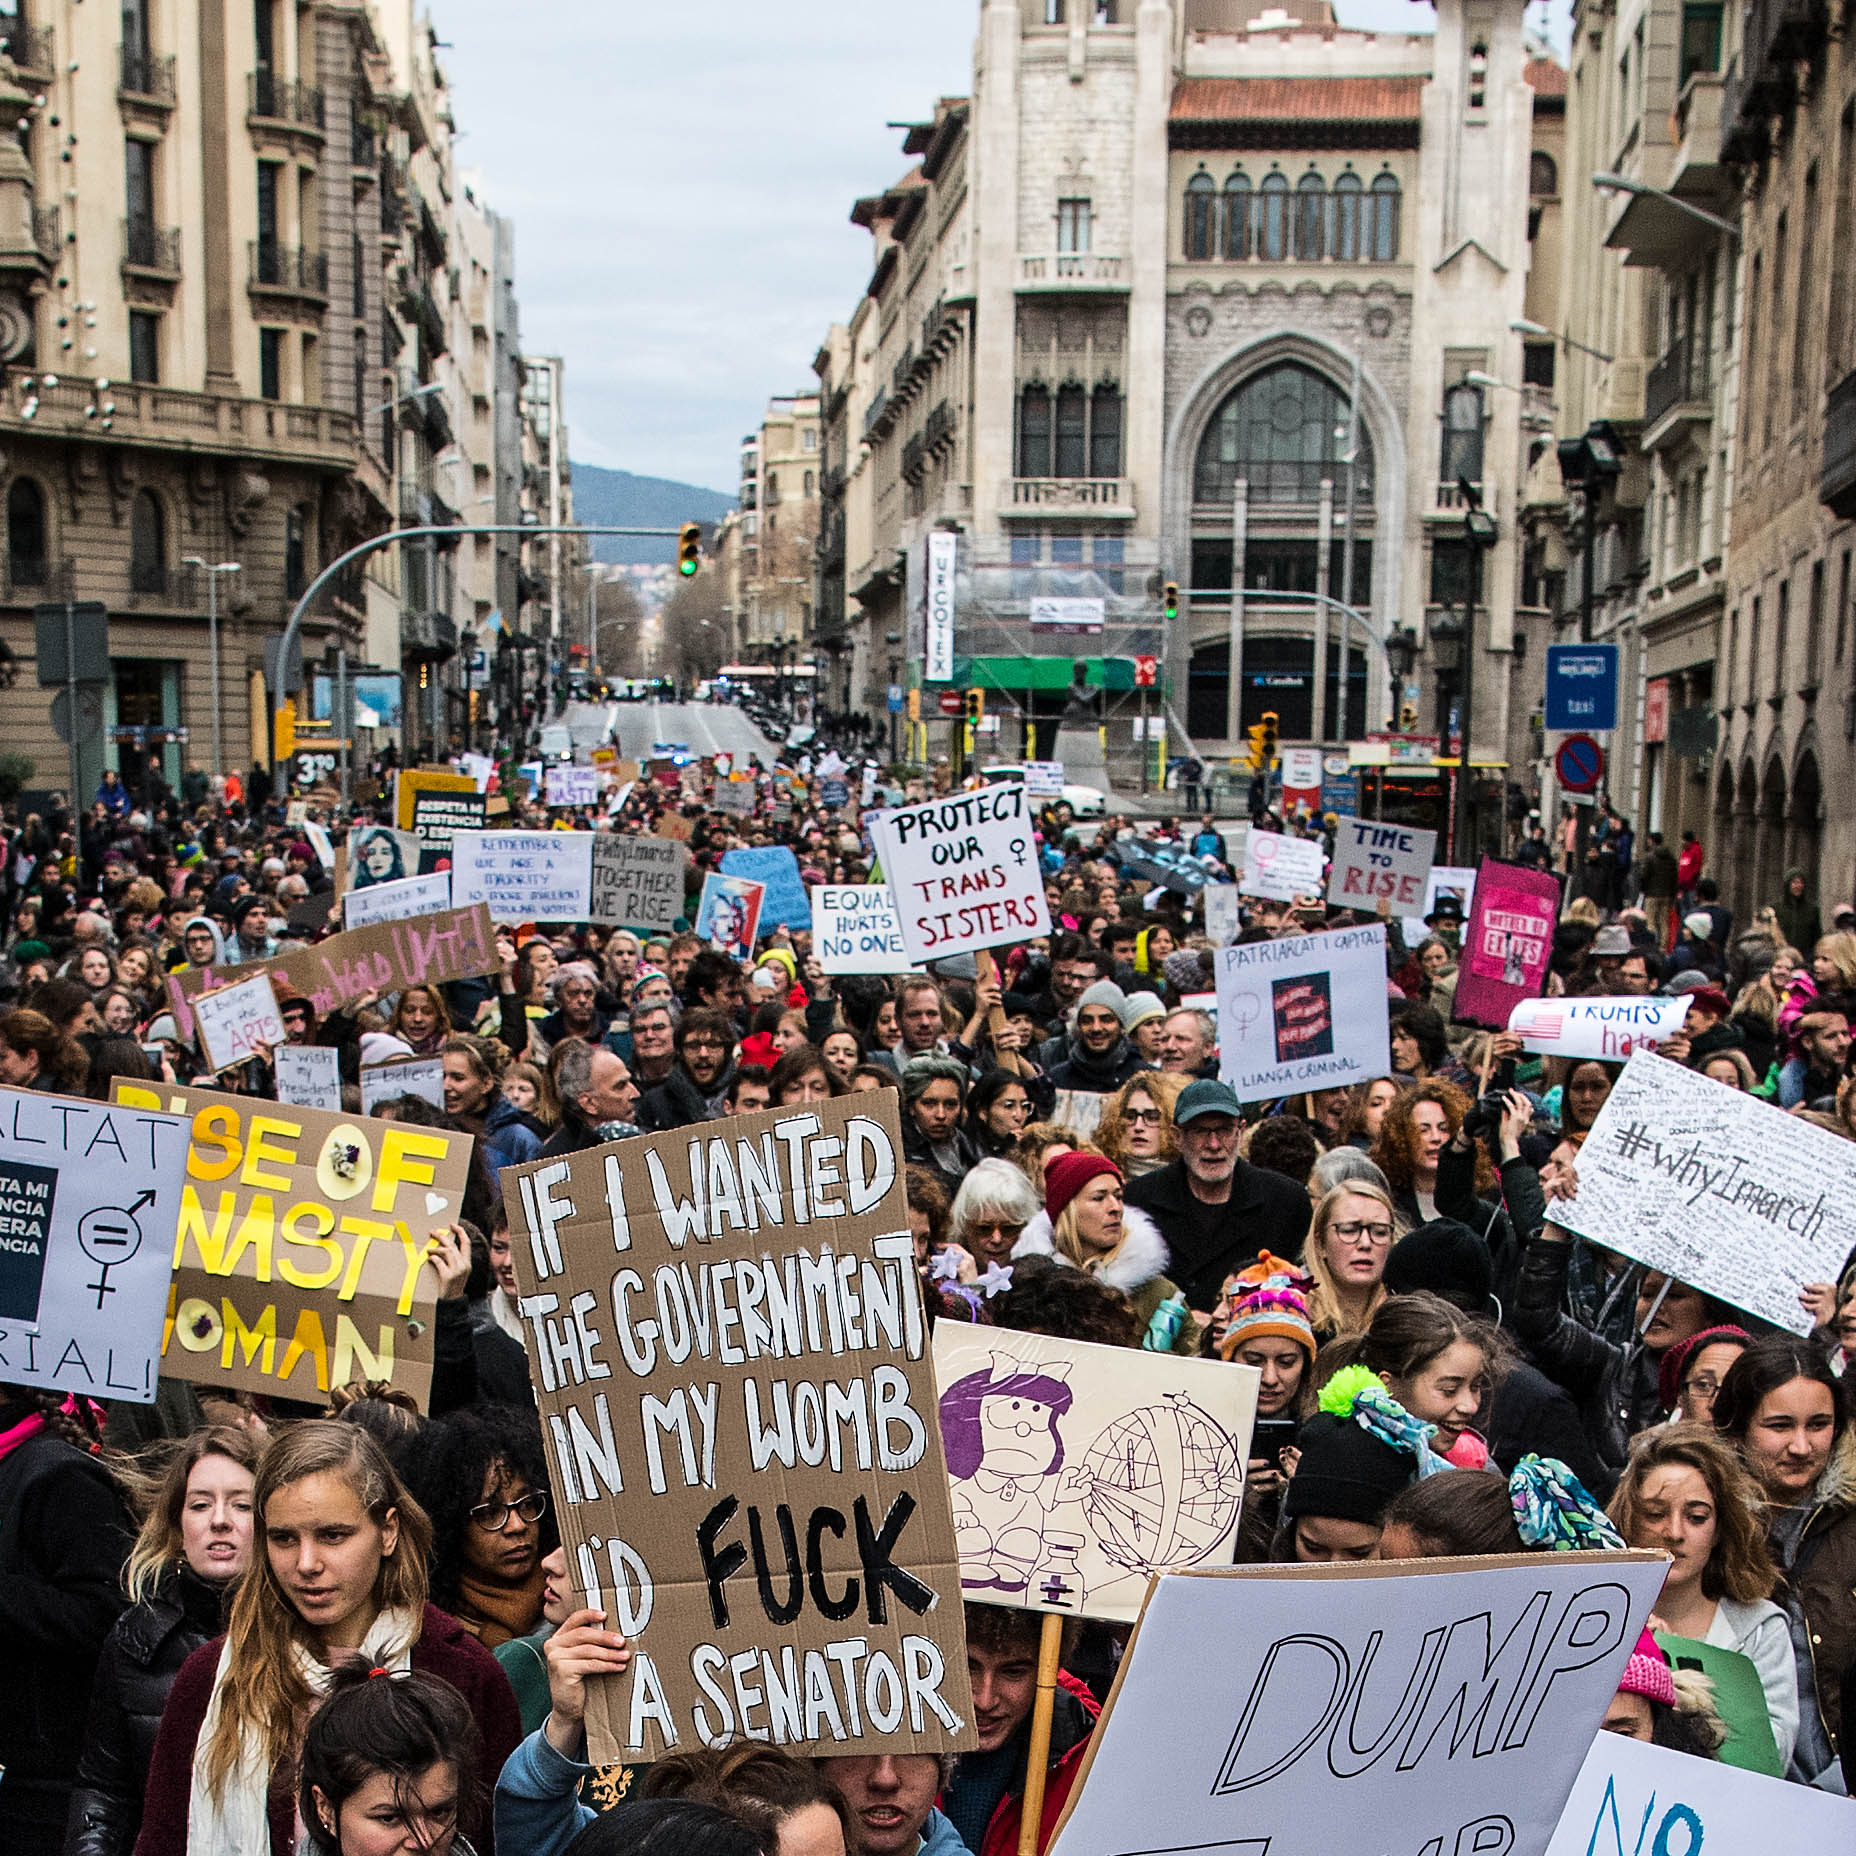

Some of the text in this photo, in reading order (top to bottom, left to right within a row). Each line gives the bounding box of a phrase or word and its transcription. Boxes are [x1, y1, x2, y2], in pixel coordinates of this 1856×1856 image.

[890, 787, 1024, 844] PROTECT
[932, 836, 984, 866] OUR
[1353, 822, 1414, 853] TIME
[594, 864, 677, 894] TOGETHER
[1369, 853, 1394, 867] TO
[913, 865, 1007, 903] TRANS
[1343, 866, 1424, 905] RISE
[627, 896, 673, 922] RISE
[916, 895, 1038, 947] SISTERS
[823, 934, 905, 958] NO ONE
[1226, 936, 1318, 971] PATRIARCAT
[1334, 930, 1384, 951] CAPITAL
[201, 1003, 211, 1020] I
[231, 1015, 279, 1056] ARTS
[279, 1049, 334, 1065] I wish
[383, 1064, 437, 1082] believe
[1296, 1056, 1361, 1081] CRIMINAL
[279, 1078, 337, 1097] President
[315, 1122, 451, 1213] OF
[25, 1181, 49, 1199] MI
[517, 1112, 897, 1283] IF I WANTED
[172, 1185, 453, 1316] NASTY
[518, 1229, 924, 1394] THE GOVERNMENT
[160, 1283, 396, 1393] OMAN
[549, 1364, 930, 1504] IN MY WOMB
[575, 1489, 942, 1639] I'D FUCK
[622, 1633, 968, 1752] A SENATOR
[1210, 1581, 1634, 1797] DUMP
